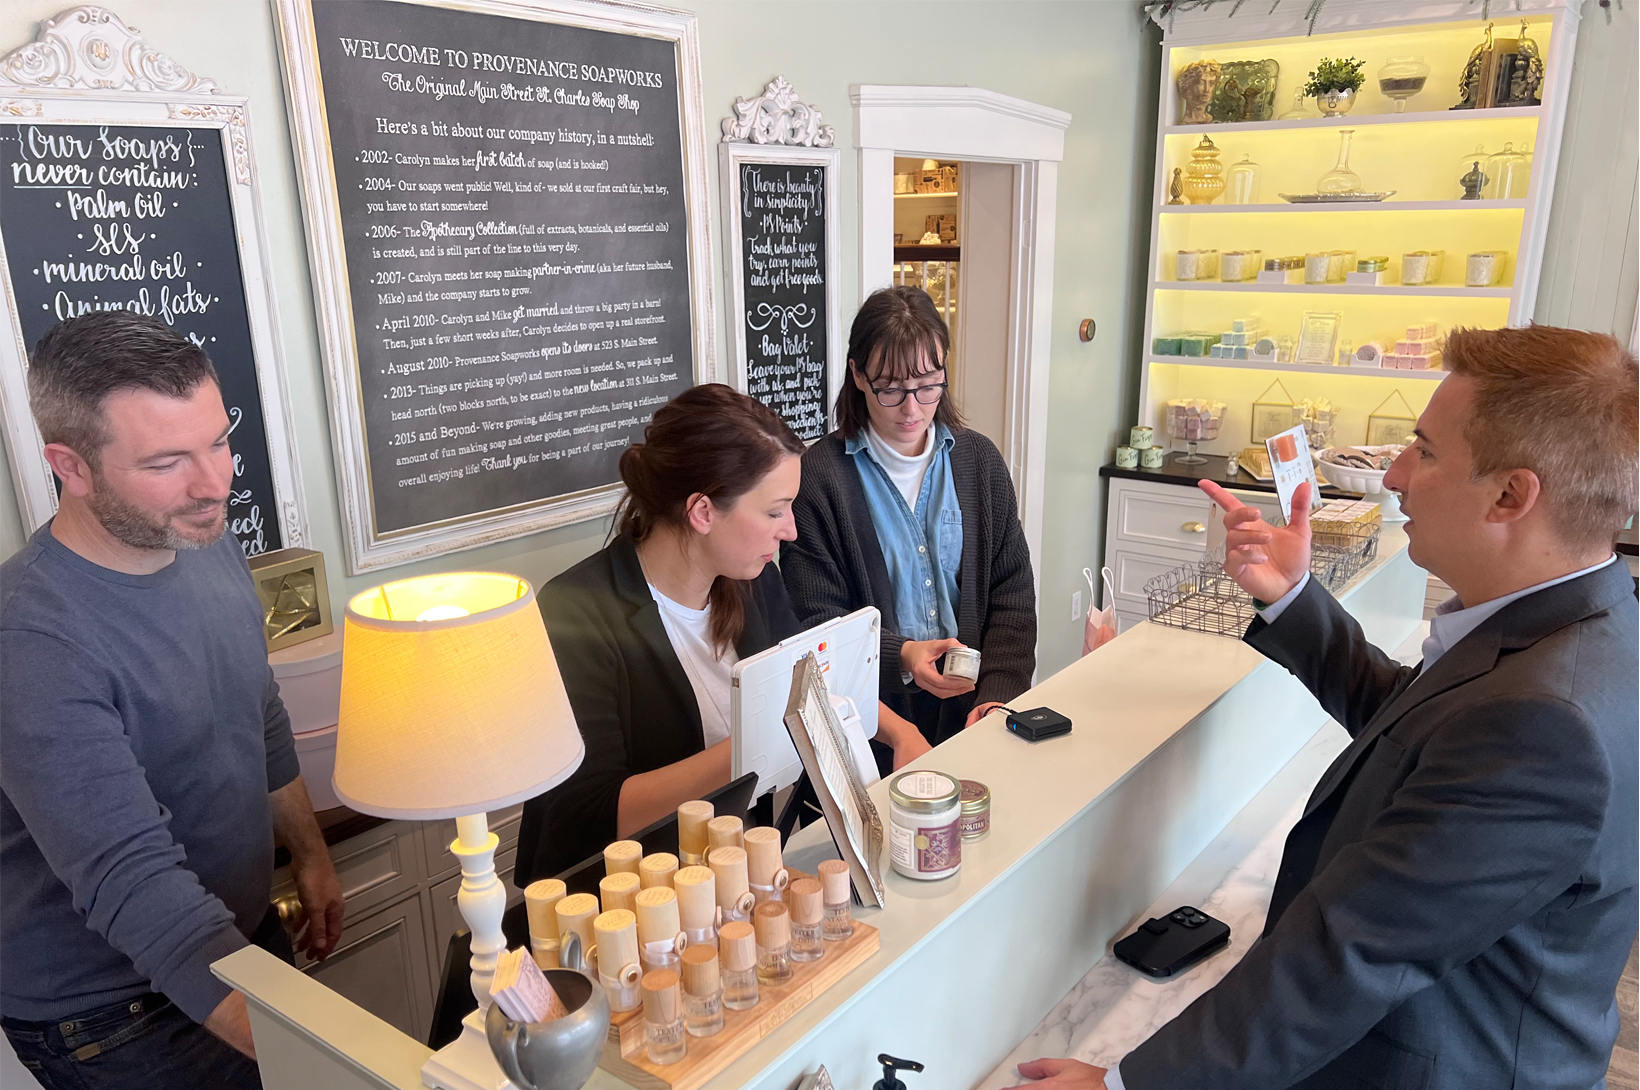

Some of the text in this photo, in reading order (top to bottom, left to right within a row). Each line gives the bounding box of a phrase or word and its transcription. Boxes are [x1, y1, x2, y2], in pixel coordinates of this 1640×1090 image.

[339, 37, 662, 88] WELCOME TO PROVENANCE SOAPWORKS
[381, 71, 639, 115] The Original Main Street St. Charles Soap Shop
[375, 117, 654, 146] Here's a bit about our company history, in a nutshell:
[28, 125, 182, 169] Our Soaps
[394, 152, 430, 167] Carolyn
[432, 154, 459, 165] makes
[462, 155, 475, 167] her
[474, 150, 498, 171] first
[498, 150, 526, 167] batch
[526, 157, 535, 167] of
[537, 160, 554, 170] soap
[572, 158, 579, 169] is
[11, 162, 199, 190] never contain:
[397, 179, 416, 191] Our
[418, 182, 441, 194] soaps
[443, 182, 464, 191] went
[514, 181, 532, 192] kind
[546, 184, 557, 192] we
[558, 182, 573, 192] sold
[574, 184, 581, 192] at
[596, 182, 610, 192] first
[611, 183, 628, 193] craft
[642, 183, 654, 193] but
[748, 167, 818, 209] There is beauty
[67, 189, 166, 221] Palm Oil
[366, 203, 384, 214] you
[385, 200, 407, 211] have
[408, 201, 418, 211] to
[419, 201, 439, 211] start
[754, 192, 809, 220] in simplicity
[402, 226, 420, 237] The
[420, 219, 475, 241] Apothecary
[475, 220, 518, 235] Collection
[536, 223, 545, 234] of
[614, 222, 626, 232] and
[627, 222, 654, 232] essential
[775, 214, 803, 234] Points
[86, 222, 146, 256] SLS
[746, 234, 818, 258] Track what you
[43, 251, 187, 284] mineral oil
[748, 252, 819, 275] try, earn points
[750, 269, 771, 287] and
[770, 268, 785, 294] get
[784, 268, 802, 289] free
[158, 281, 212, 327] fats
[381, 315, 410, 332] April
[440, 313, 473, 325] Carolyn
[475, 310, 490, 321] and
[491, 309, 512, 320] Mike
[512, 304, 525, 323] get
[526, 301, 559, 317] married
[560, 304, 573, 314] and
[574, 304, 594, 313] throw
[601, 301, 612, 313] big
[613, 302, 630, 313] party
[631, 299, 638, 309] in
[762, 332, 809, 364] Bag Valet
[747, 359, 775, 379] Leave
[774, 364, 797, 382] your
[806, 355, 825, 379] bag
[749, 377, 771, 394] with
[785, 372, 801, 389] and
[803, 372, 821, 391] pick
[773, 389, 797, 403] when
[394, 430, 416, 445] 2015
[418, 427, 437, 441] and
[538, 410, 562, 422] adding
[563, 409, 578, 418] new
[611, 399, 633, 410] having
[638, 394, 668, 406] ridiculous
[781, 400, 821, 420] shopping
